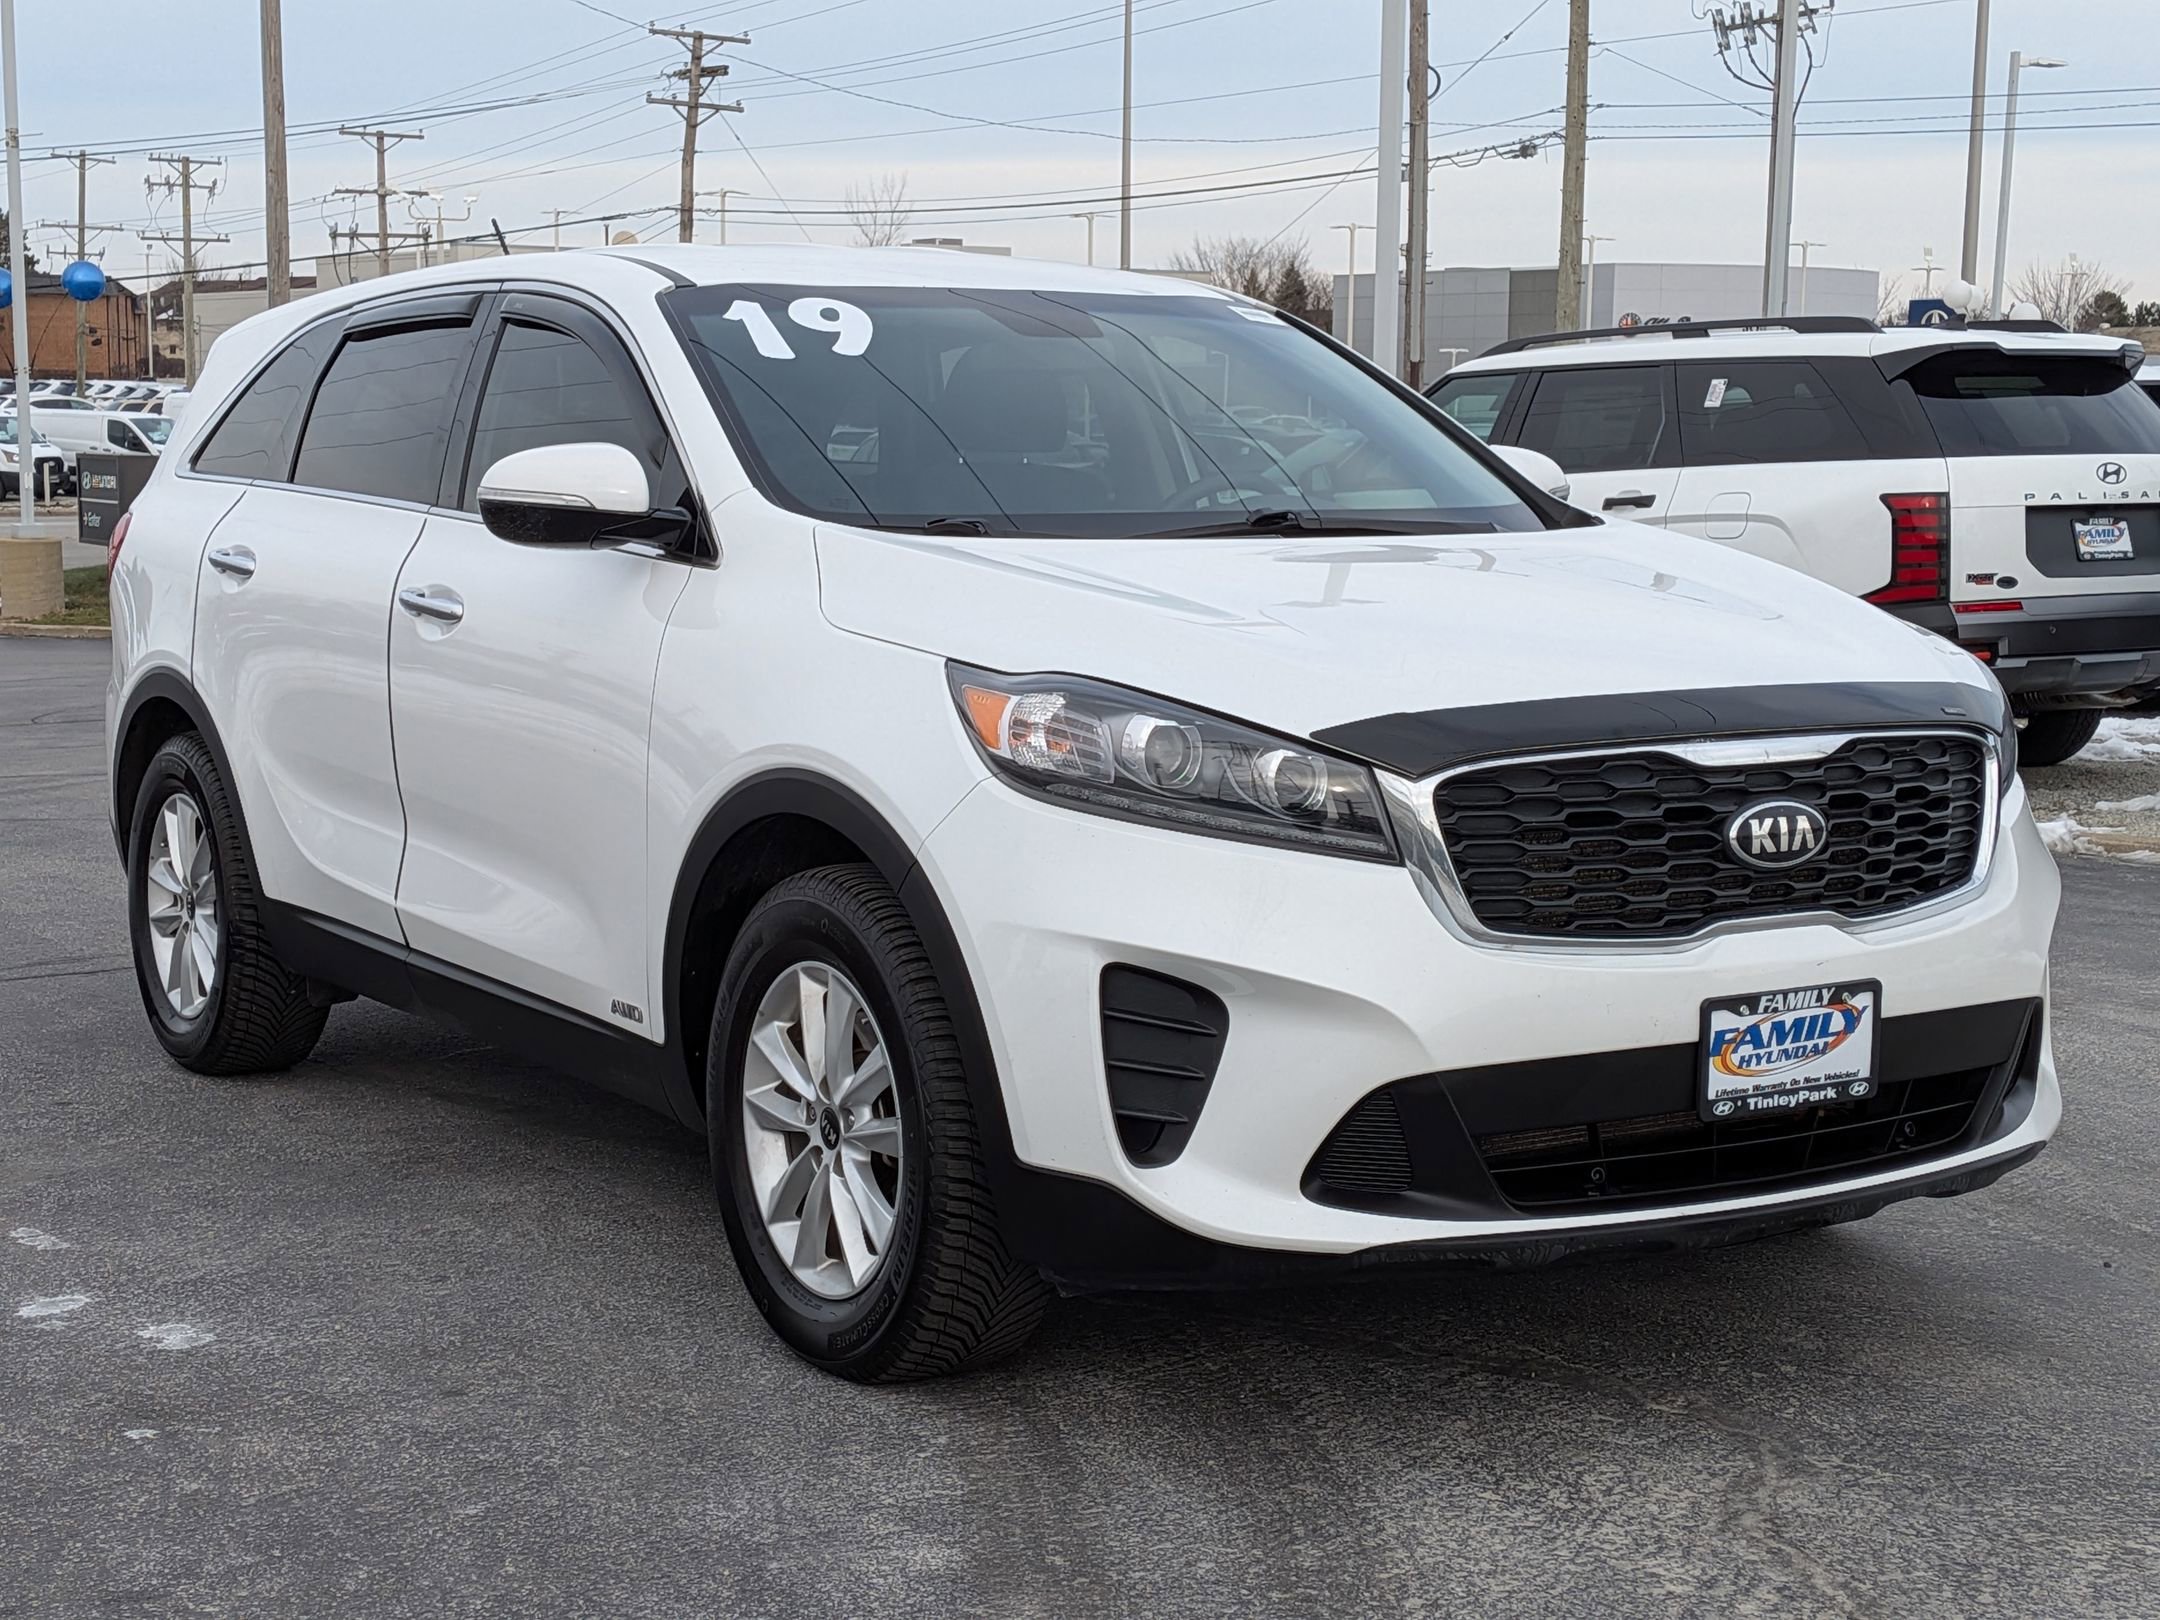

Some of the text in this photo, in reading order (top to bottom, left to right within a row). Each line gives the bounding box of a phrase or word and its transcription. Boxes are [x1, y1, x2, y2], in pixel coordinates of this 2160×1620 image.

[722, 297, 873, 360] 19
[2024, 491, 2160, 501] PALISA
[2078, 527, 2126, 539] FAMILY
[2089, 517, 2114, 525] FAMILY
[1748, 815, 1815, 855] KIA
[611, 998, 643, 1024] AWD
[1757, 987, 1836, 1014] FAMILY
[1709, 1005, 1871, 1057] FAMILY
[1737, 1041, 1830, 1069] HYUNDAI
[1714, 1087, 1750, 1099] Lifetime
[1752, 1080, 1788, 1093] Warranty
[1790, 1078, 1801, 1087] On
[1803, 1076, 1822, 1085] New
[889, 1166, 918, 1288] MICHELIN
